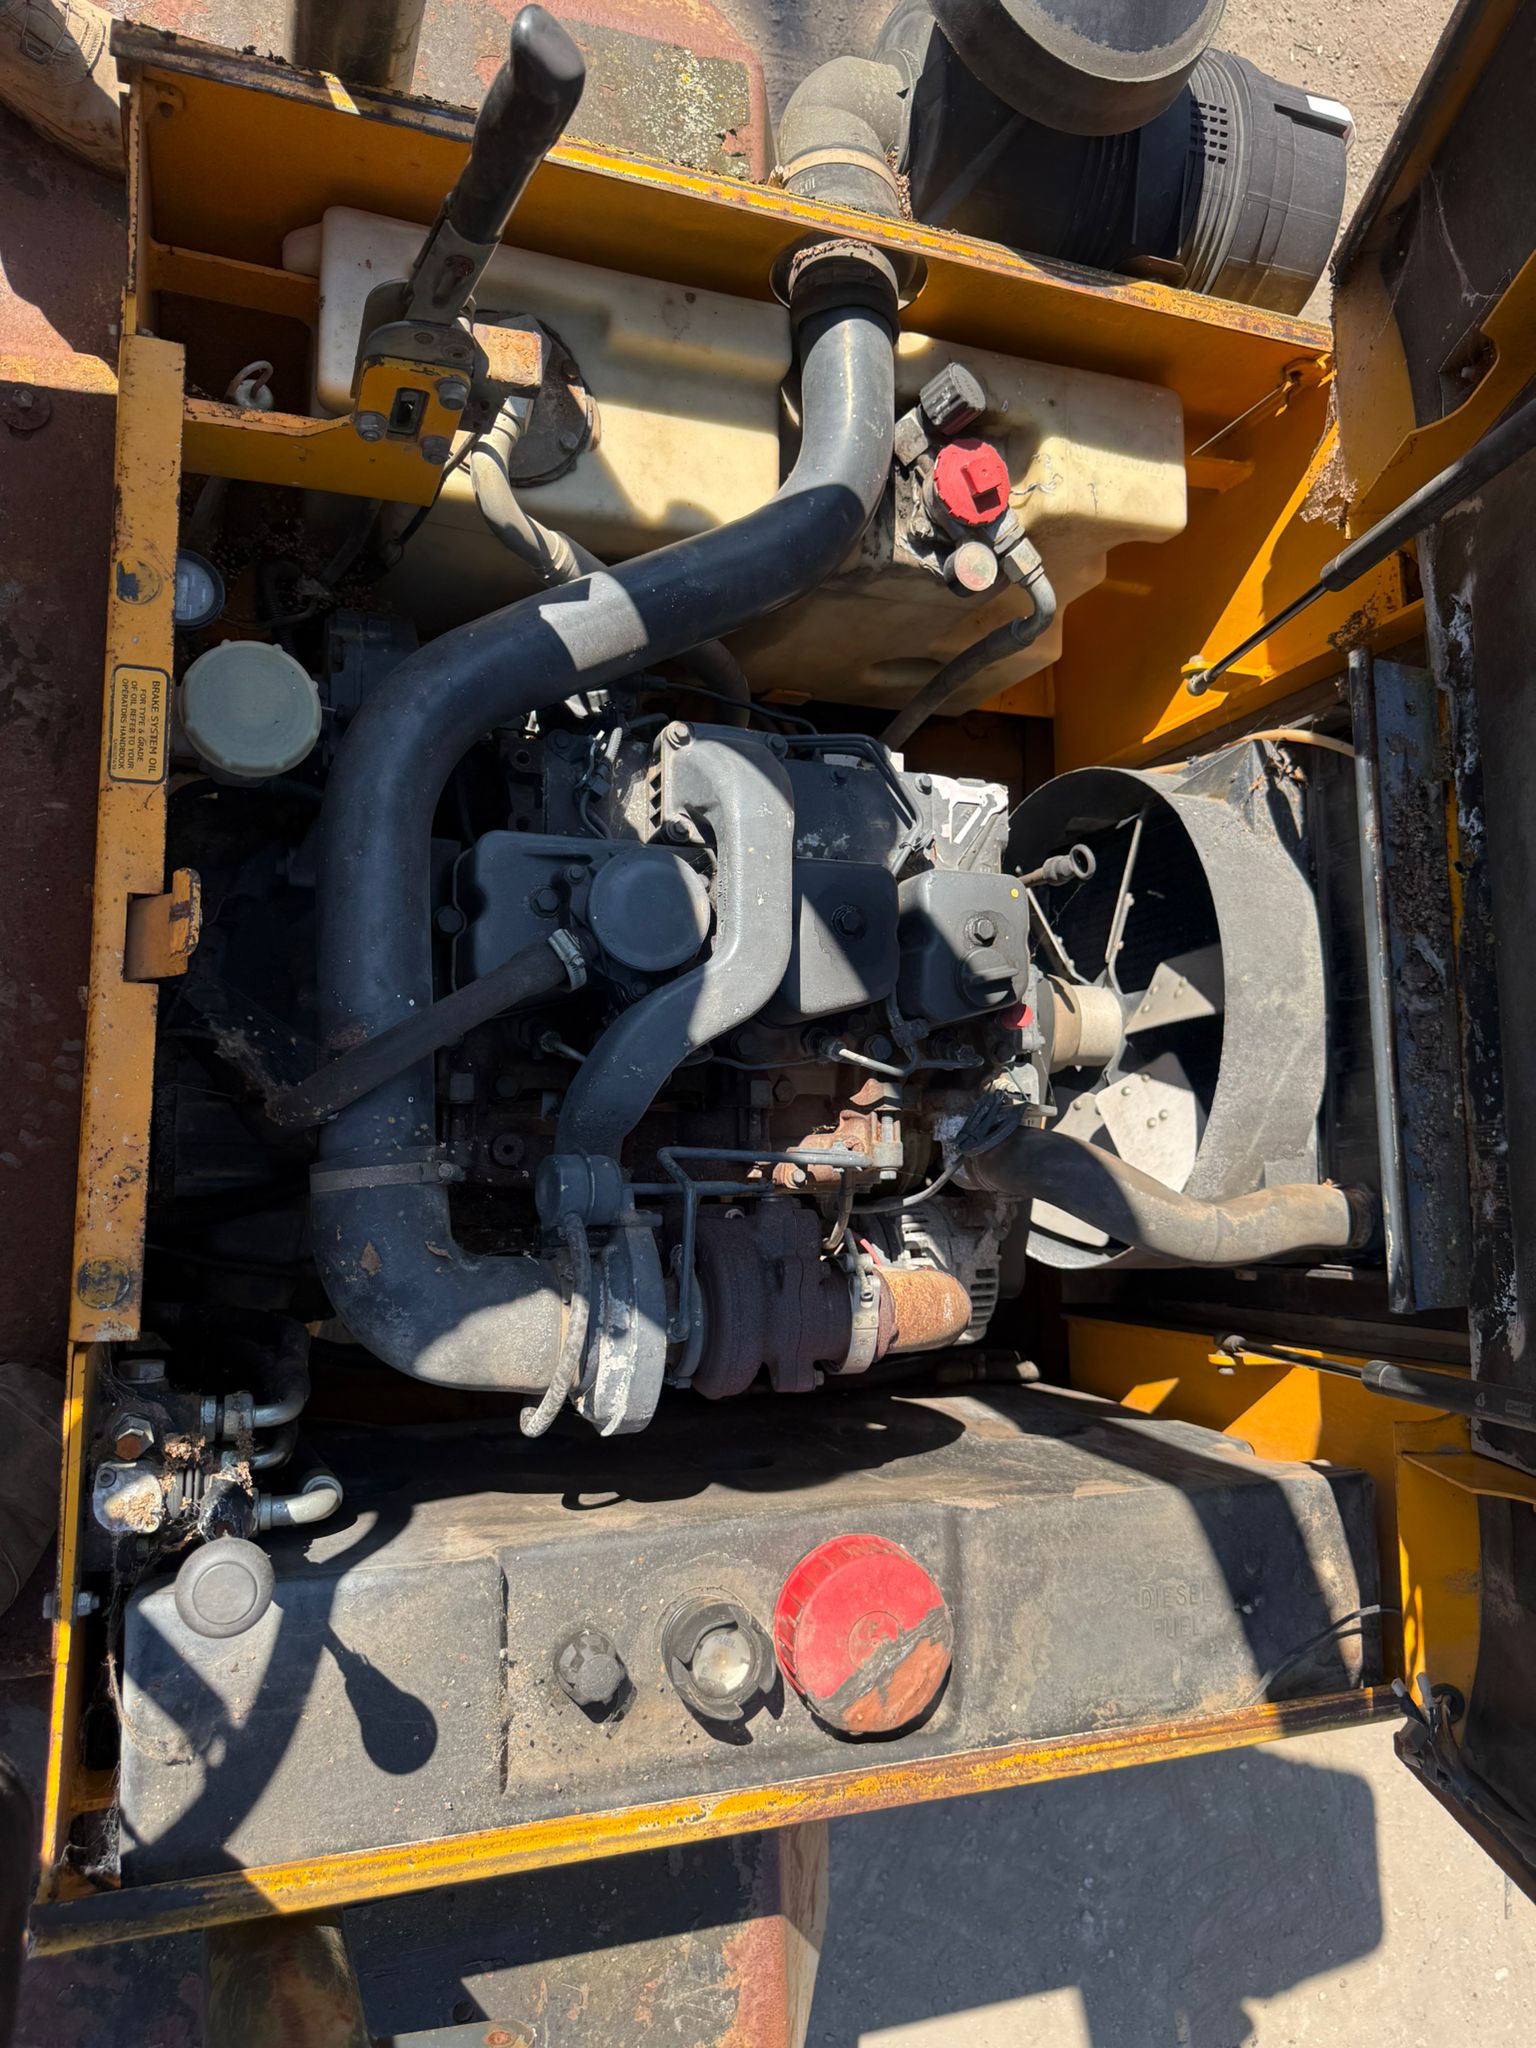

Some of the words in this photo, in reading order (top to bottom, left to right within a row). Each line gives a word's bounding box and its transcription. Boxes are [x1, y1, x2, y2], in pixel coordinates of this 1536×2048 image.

[130, 680, 138, 692] OF
[151, 680, 160, 713] BRAKE
[120, 678, 128, 724] OPERATORS
[129, 693, 137, 706] OIL
[138, 706, 146, 726] TYPE
[118, 725, 126, 769] HANDBOOK
[128, 736, 135, 746] TO
[149, 716, 159, 755] SYSTEM
[127, 748, 135, 769] YOUR
[137, 736, 147, 763] GRADE
[148, 757, 157, 774] OIL
[1141, 1580, 1210, 1610] DIESEL
[1152, 1615, 1202, 1641] FUEL
